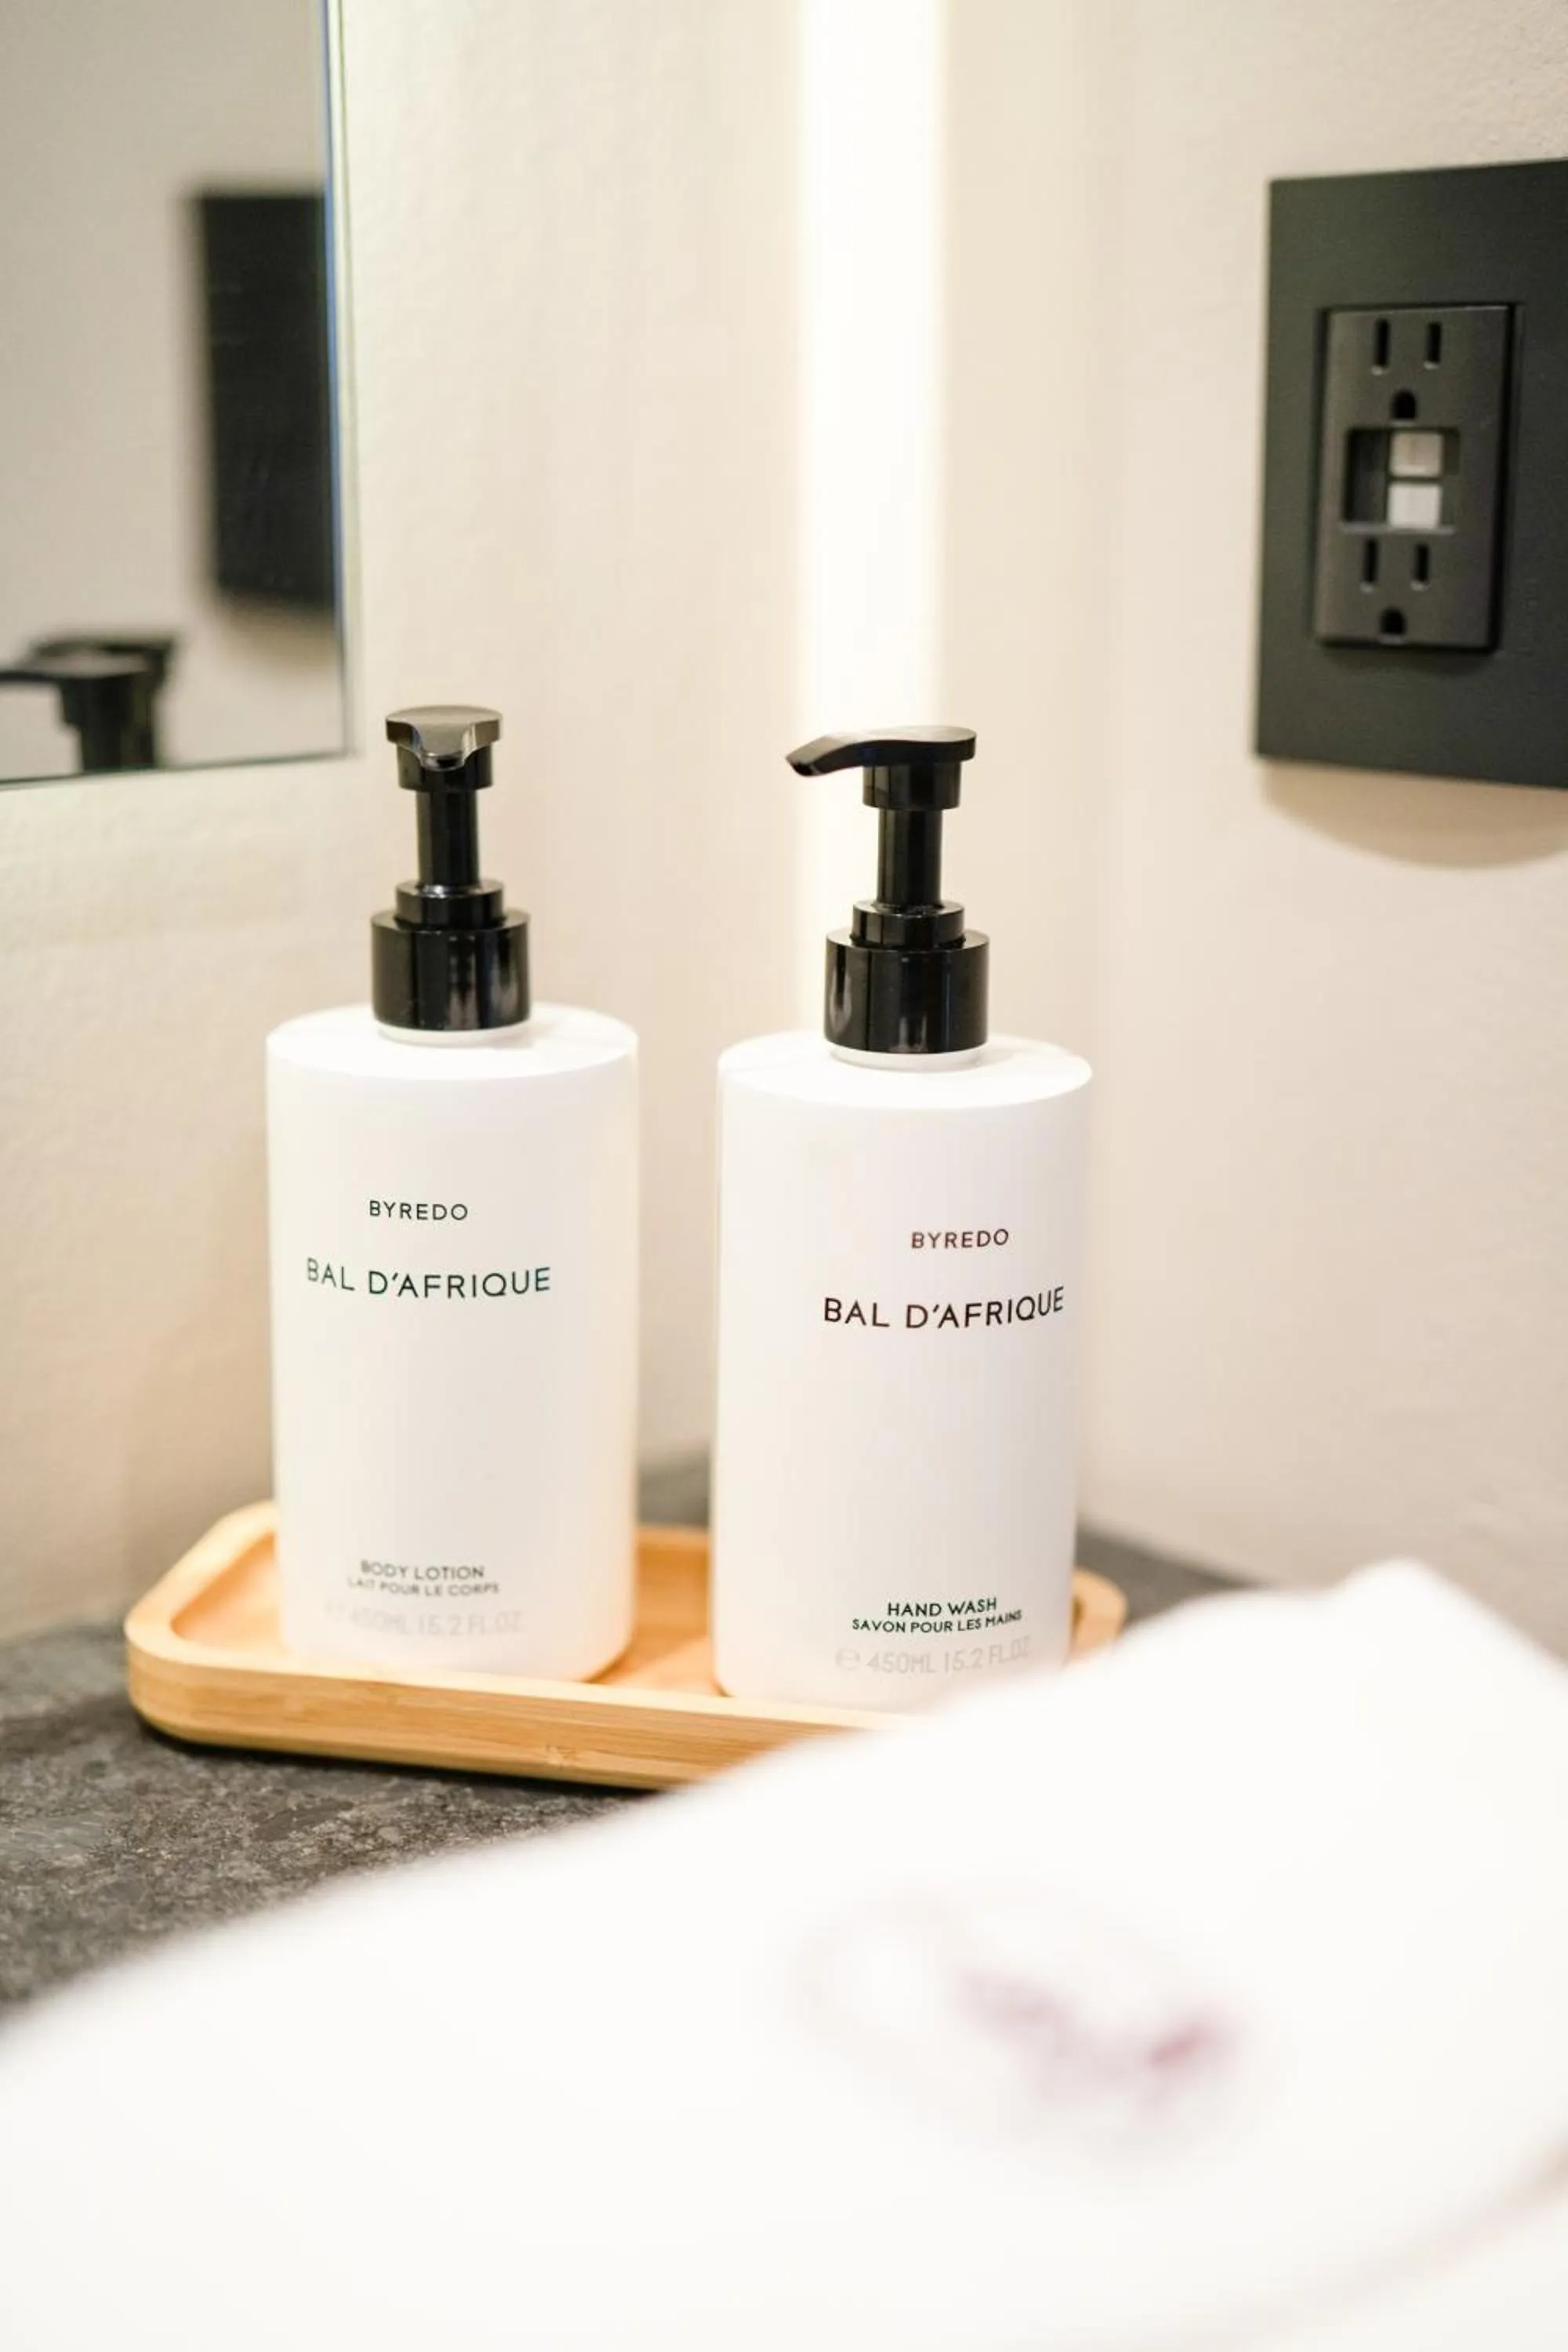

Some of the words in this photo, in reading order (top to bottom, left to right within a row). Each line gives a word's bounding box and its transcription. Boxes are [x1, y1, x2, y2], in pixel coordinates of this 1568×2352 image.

[368, 1200, 469, 1221] BYREDO
[911, 1229, 1009, 1249] BYREDO
[307, 1257, 355, 1291] BAL
[368, 1266, 551, 1298] D'AFRIQUE
[824, 1297, 890, 1327] BAL
[906, 1286, 1064, 1329] D'AFRIQUE
[361, 1559, 408, 1578] BODY
[414, 1566, 485, 1581] LOTION
[380, 1581, 420, 1596] POUR
[448, 1583, 500, 1597] CORPS
[887, 1602, 942, 1617] HAND
[947, 1597, 997, 1616] WASH
[852, 1619, 906, 1633] SAVON
[910, 1621, 953, 1633] POUR
[957, 1617, 981, 1632] LES
[985, 1609, 1023, 1628] MAINS
[866, 1650, 937, 1675] 450ML
